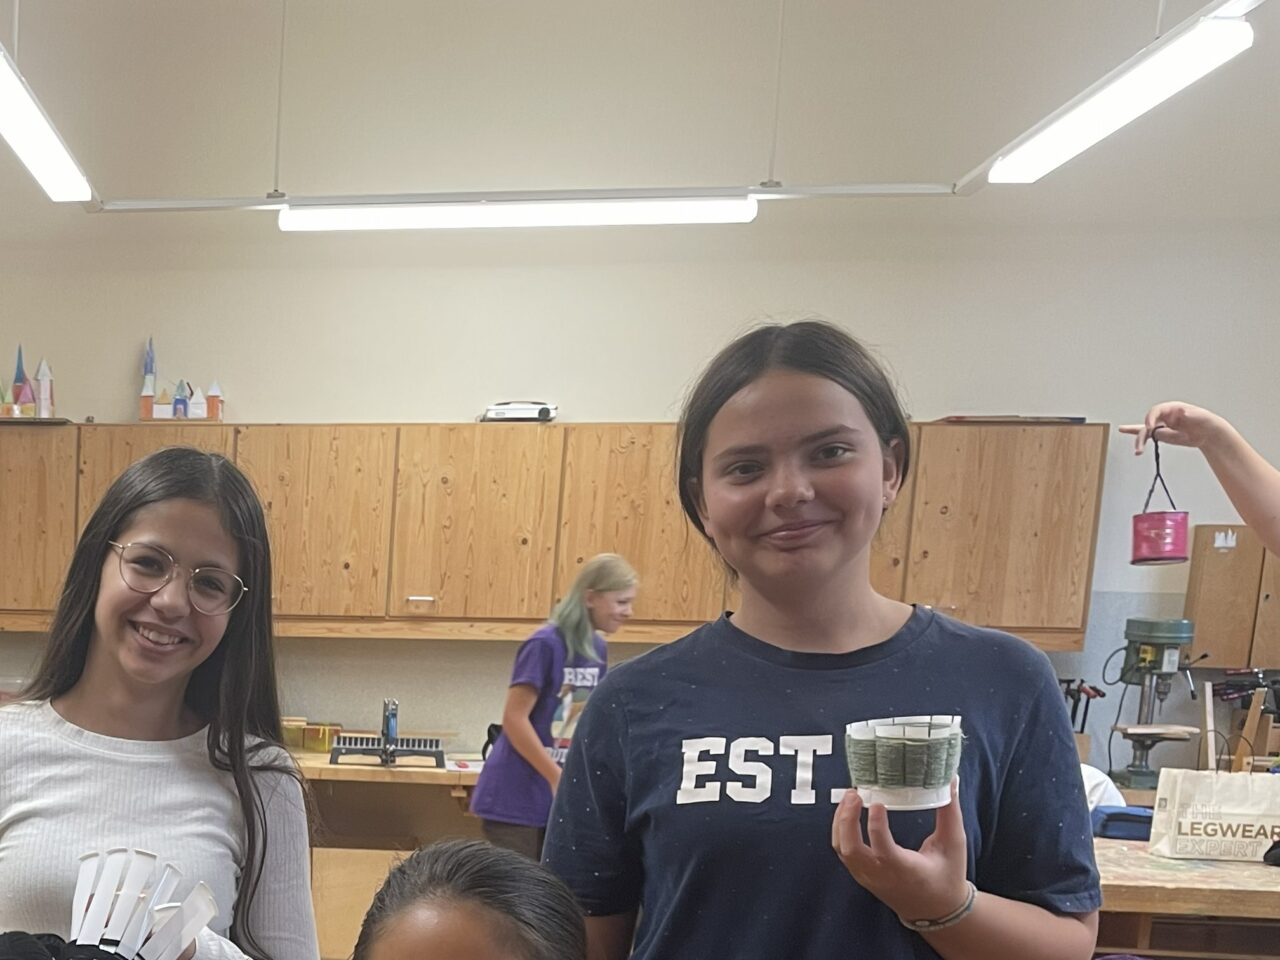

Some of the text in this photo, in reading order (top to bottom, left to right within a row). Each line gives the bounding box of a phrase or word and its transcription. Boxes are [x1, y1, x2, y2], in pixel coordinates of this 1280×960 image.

[1179, 802, 1223, 820] THE
[1177, 821, 1280, 842] LEGWEAR
[1176, 838, 1263, 858] EXPERT
